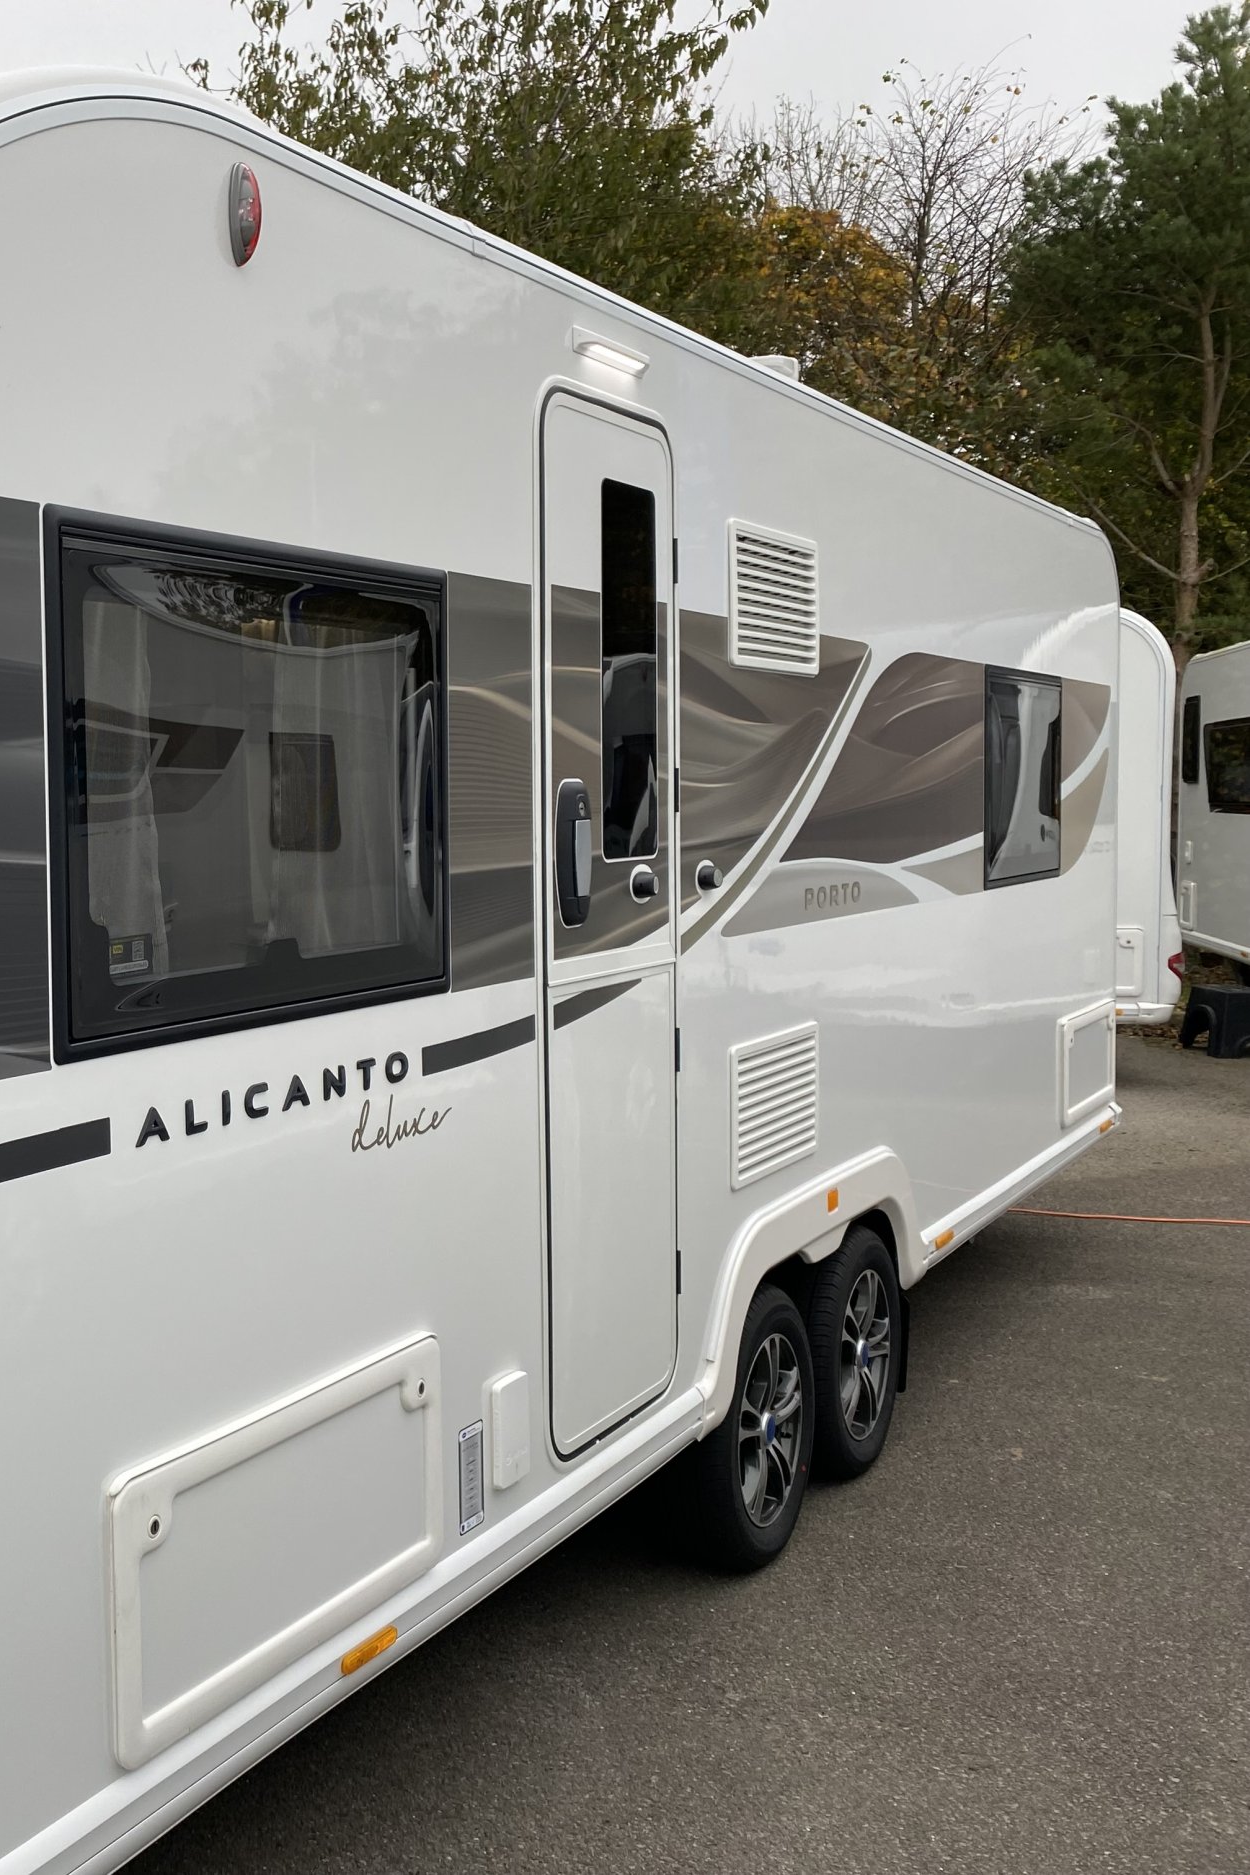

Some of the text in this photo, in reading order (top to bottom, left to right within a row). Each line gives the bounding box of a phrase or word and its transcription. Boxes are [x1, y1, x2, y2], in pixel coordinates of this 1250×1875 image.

[804, 881, 861, 911] PORTO
[135, 1051, 409, 1148] ALICANTO
[352, 1094, 452, 1151] deluxe
